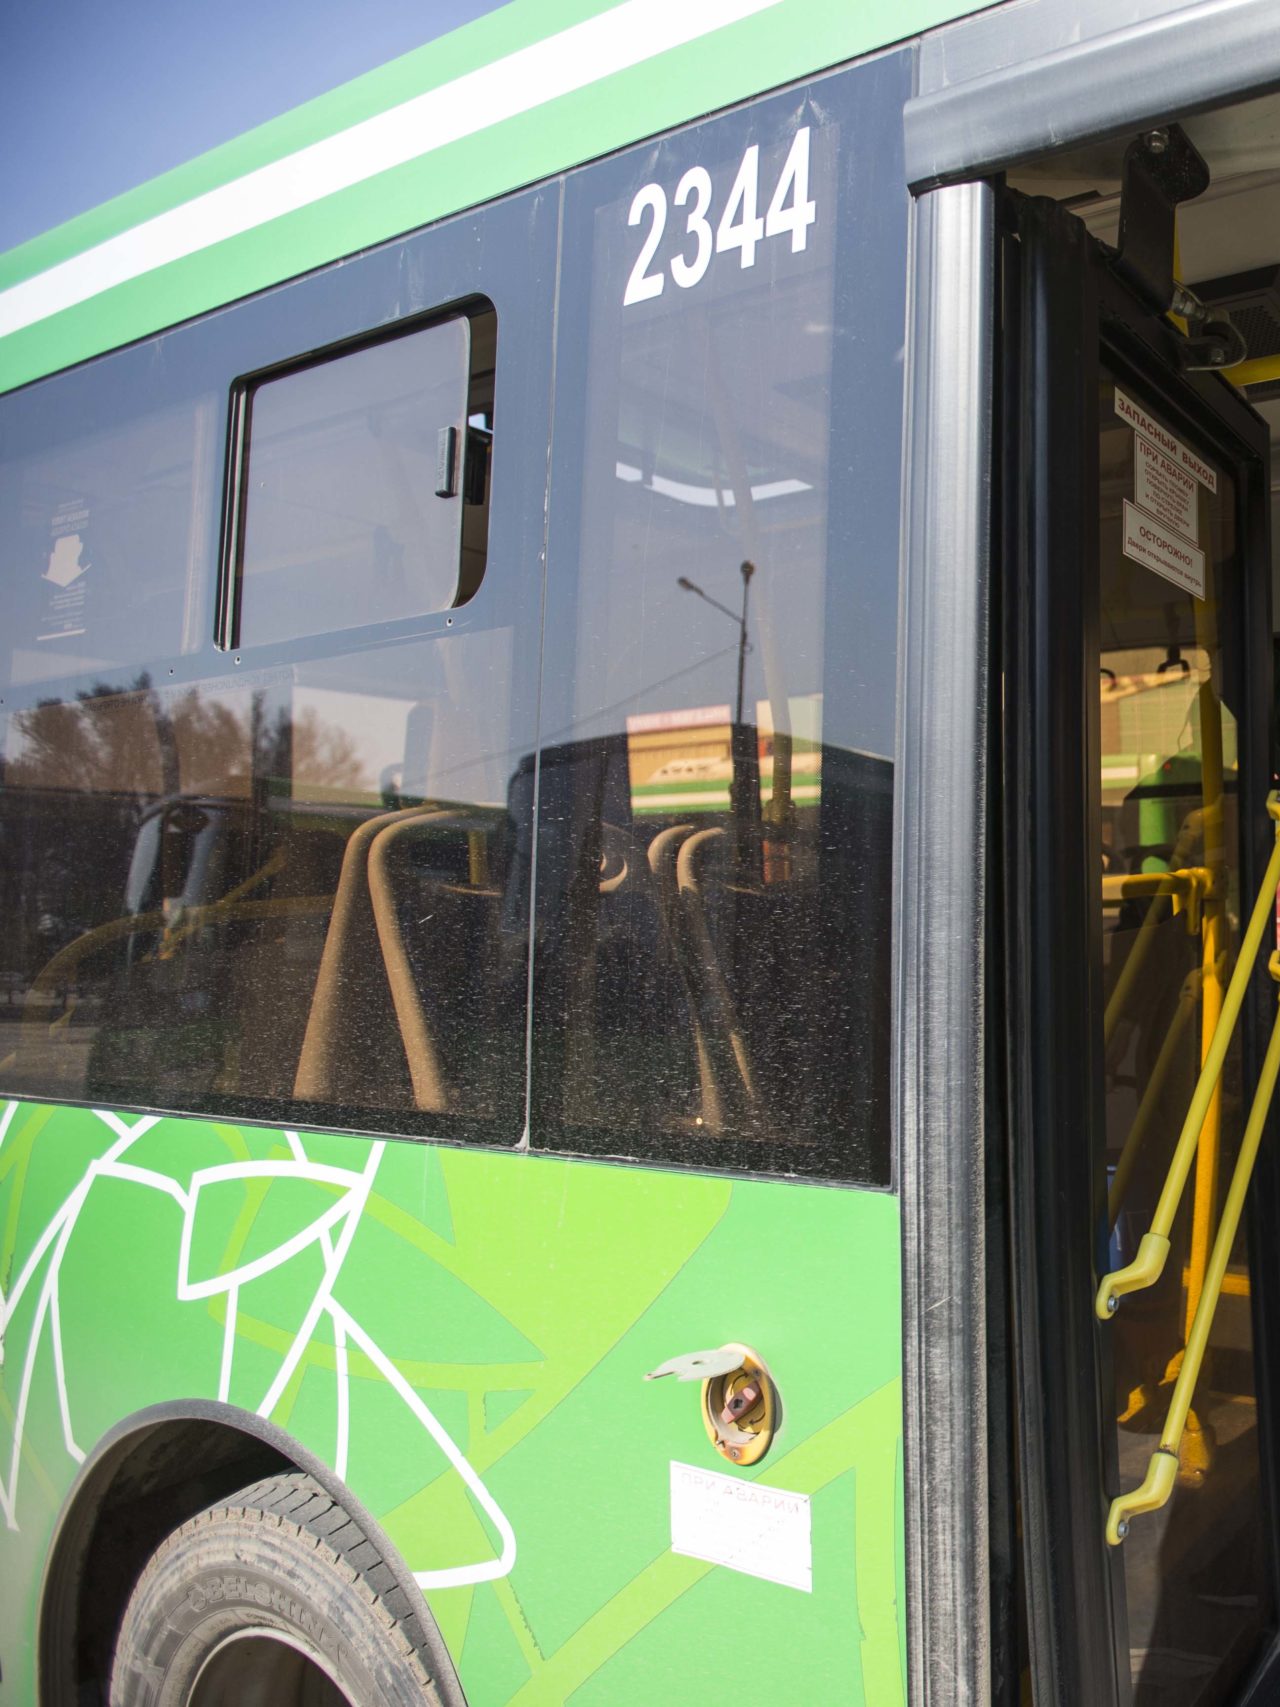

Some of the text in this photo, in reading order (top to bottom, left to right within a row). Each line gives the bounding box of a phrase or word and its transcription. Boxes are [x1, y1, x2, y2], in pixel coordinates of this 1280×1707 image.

[623, 126, 815, 306] 2344
[1118, 398, 1215, 488] ЗАПАСНЫЙ ВЫХОД
[1139, 442, 1194, 493] ПРИ АВАРИИ
[1139, 526, 1192, 568] ОСТОРОЖНО!
